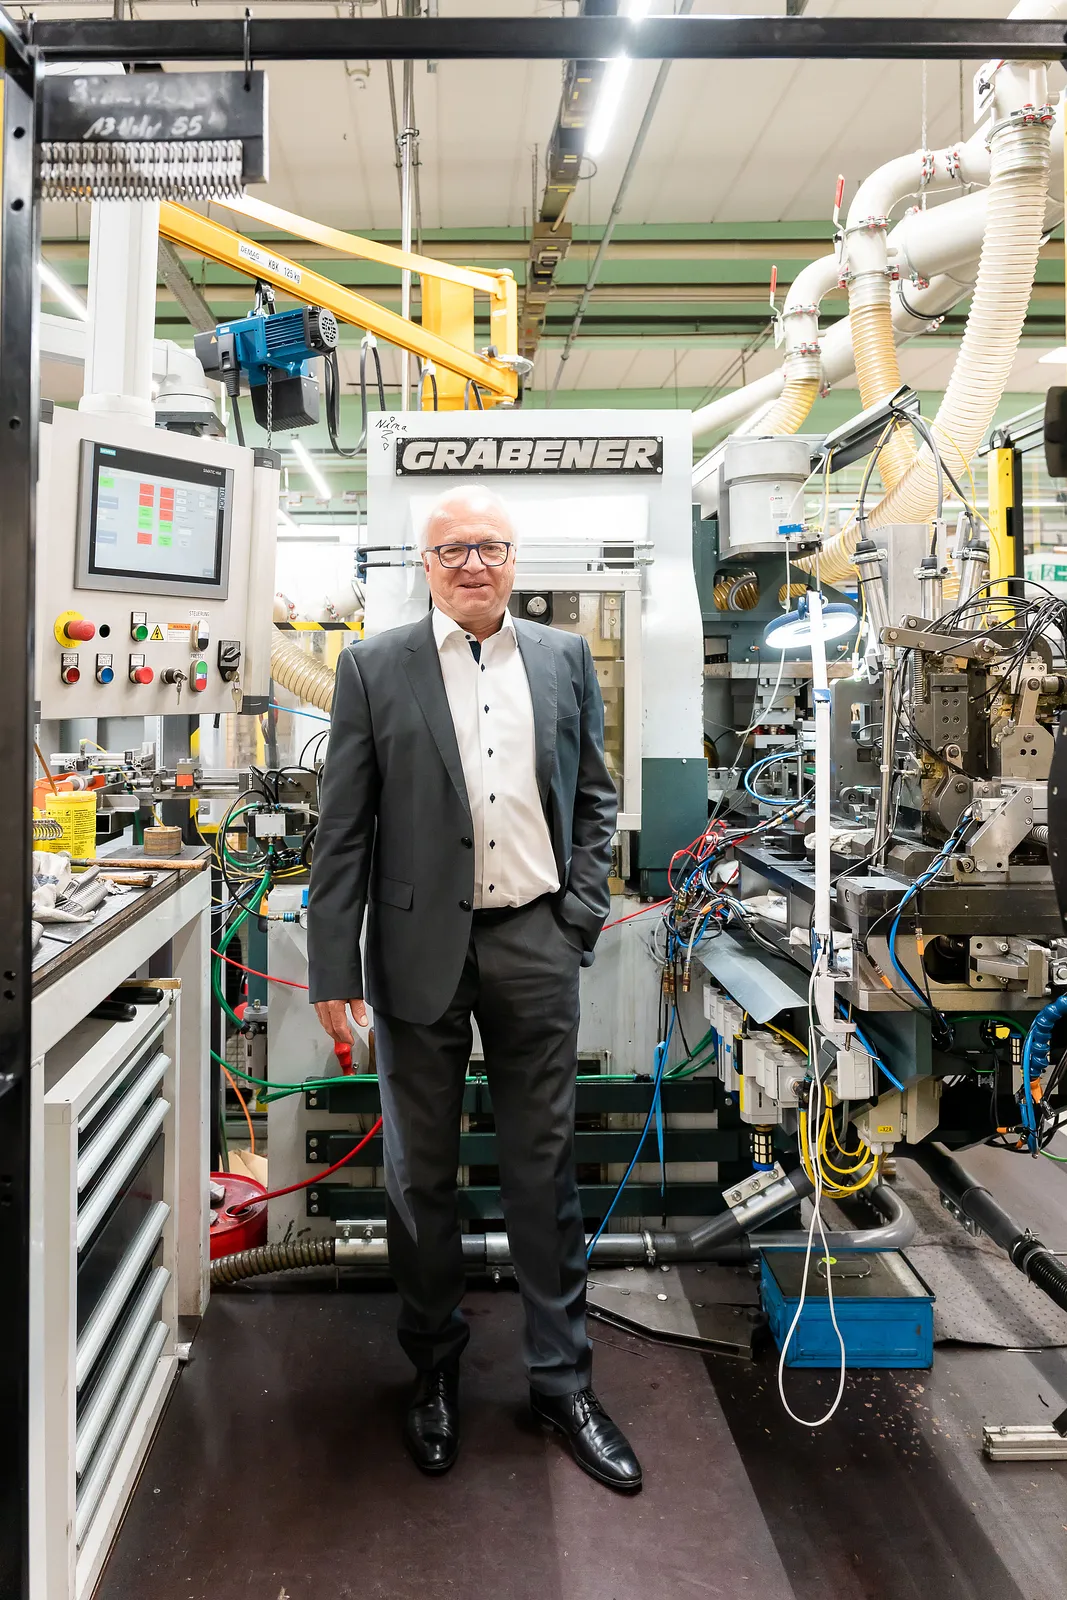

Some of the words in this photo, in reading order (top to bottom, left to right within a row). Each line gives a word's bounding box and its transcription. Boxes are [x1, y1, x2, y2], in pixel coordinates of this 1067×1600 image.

[240, 245, 260, 260] DEMAG
[267, 258, 280, 272] KBK
[401, 438, 658, 470] GRÄBENER
